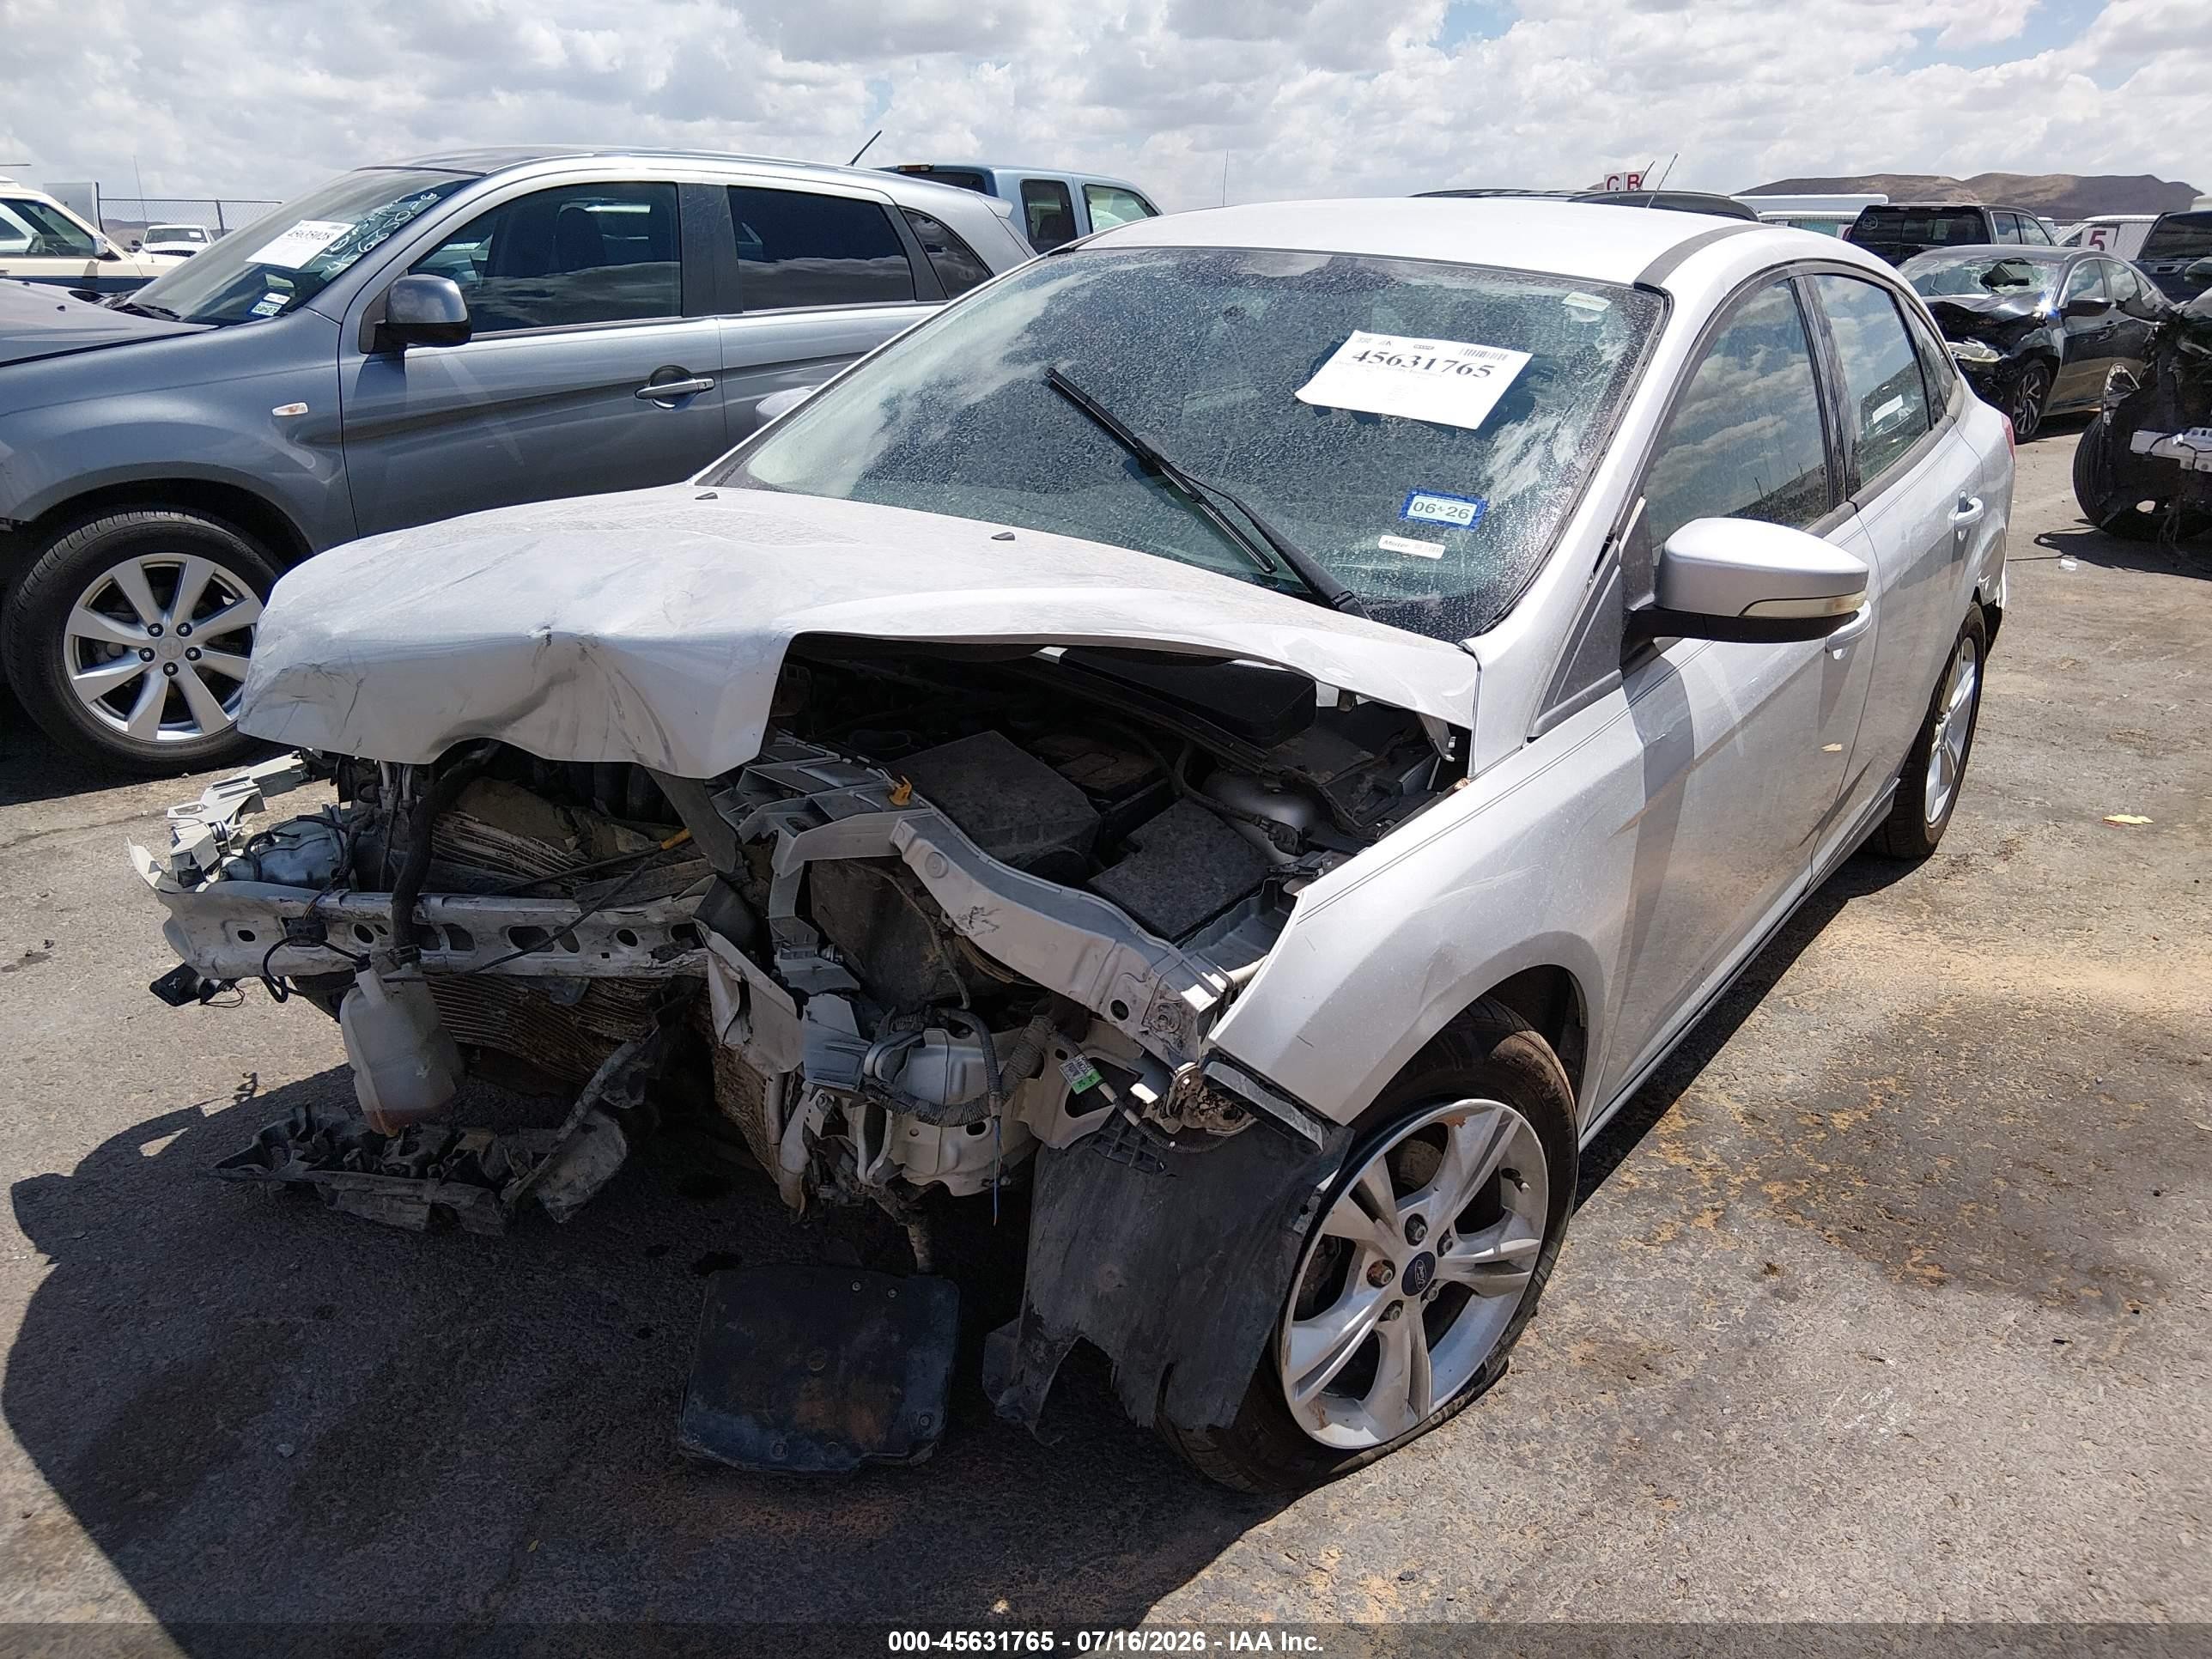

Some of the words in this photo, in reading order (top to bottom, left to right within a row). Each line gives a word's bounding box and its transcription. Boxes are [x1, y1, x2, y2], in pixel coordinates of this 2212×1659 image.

[1606, 175, 1620, 191] C
[1626, 173, 1641, 191] B
[2087, 229, 2107, 252] 5
[1352, 349, 1496, 379] 45631765
